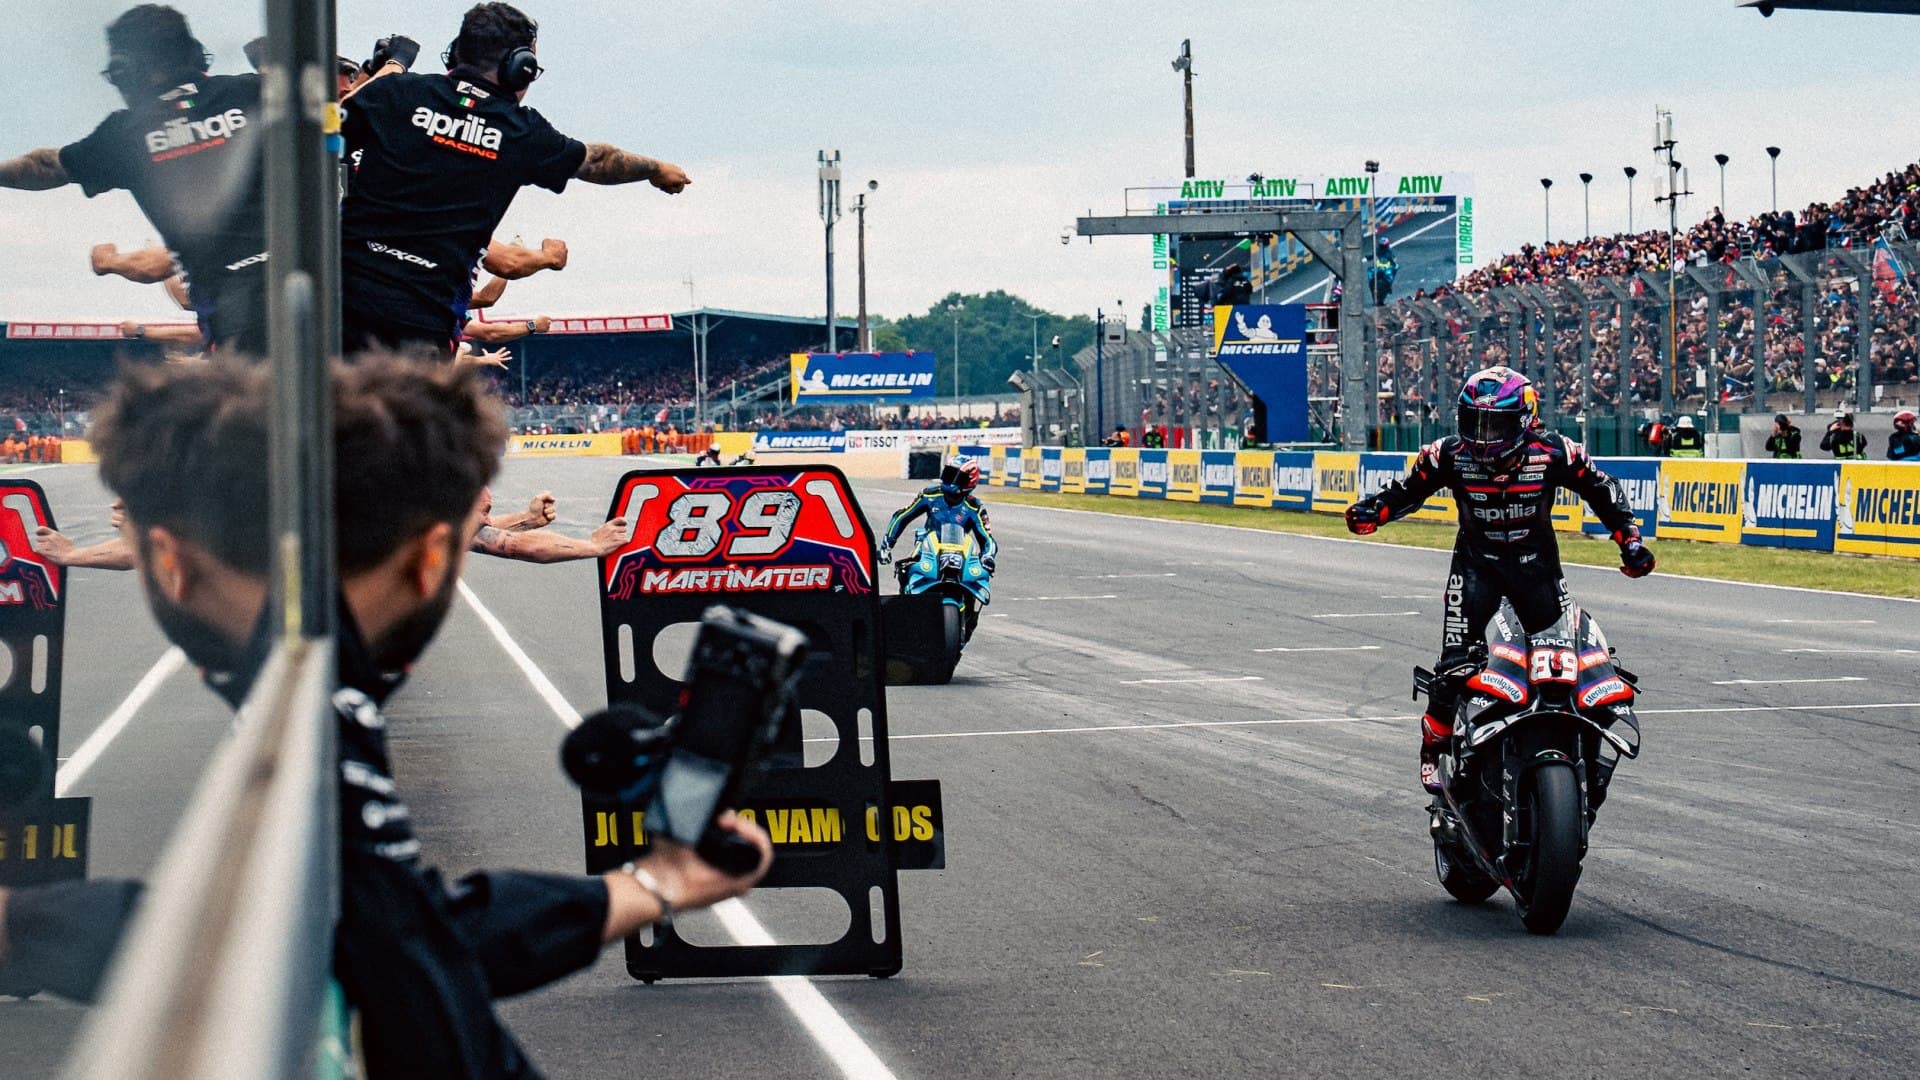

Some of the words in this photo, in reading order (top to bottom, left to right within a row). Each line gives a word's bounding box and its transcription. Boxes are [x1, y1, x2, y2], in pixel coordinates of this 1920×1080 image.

[411, 106, 503, 151] aprilia
[432, 135, 499, 160] RACING
[1181, 180, 1225, 198] AMV
[1253, 179, 1296, 197] AMV
[1325, 177, 1369, 196] AMV
[1398, 176, 1442, 193] AMV
[1220, 344, 1300, 355] MICHELIN
[830, 373, 933, 387] MICHELIN
[522, 440, 592, 449] MICHELIN
[770, 436, 845, 447] MICHELIN
[864, 436, 898, 448] TISSOT
[1672, 481, 1739, 515] MICHELIN
[1757, 484, 1834, 520] MICHELIN
[1473, 503, 1537, 522] aprilia
[655, 491, 802, 556] 89
[643, 566, 830, 591] MARTINATOR
[1445, 574, 1469, 648] aprilia
[1530, 650, 1578, 682] 89
